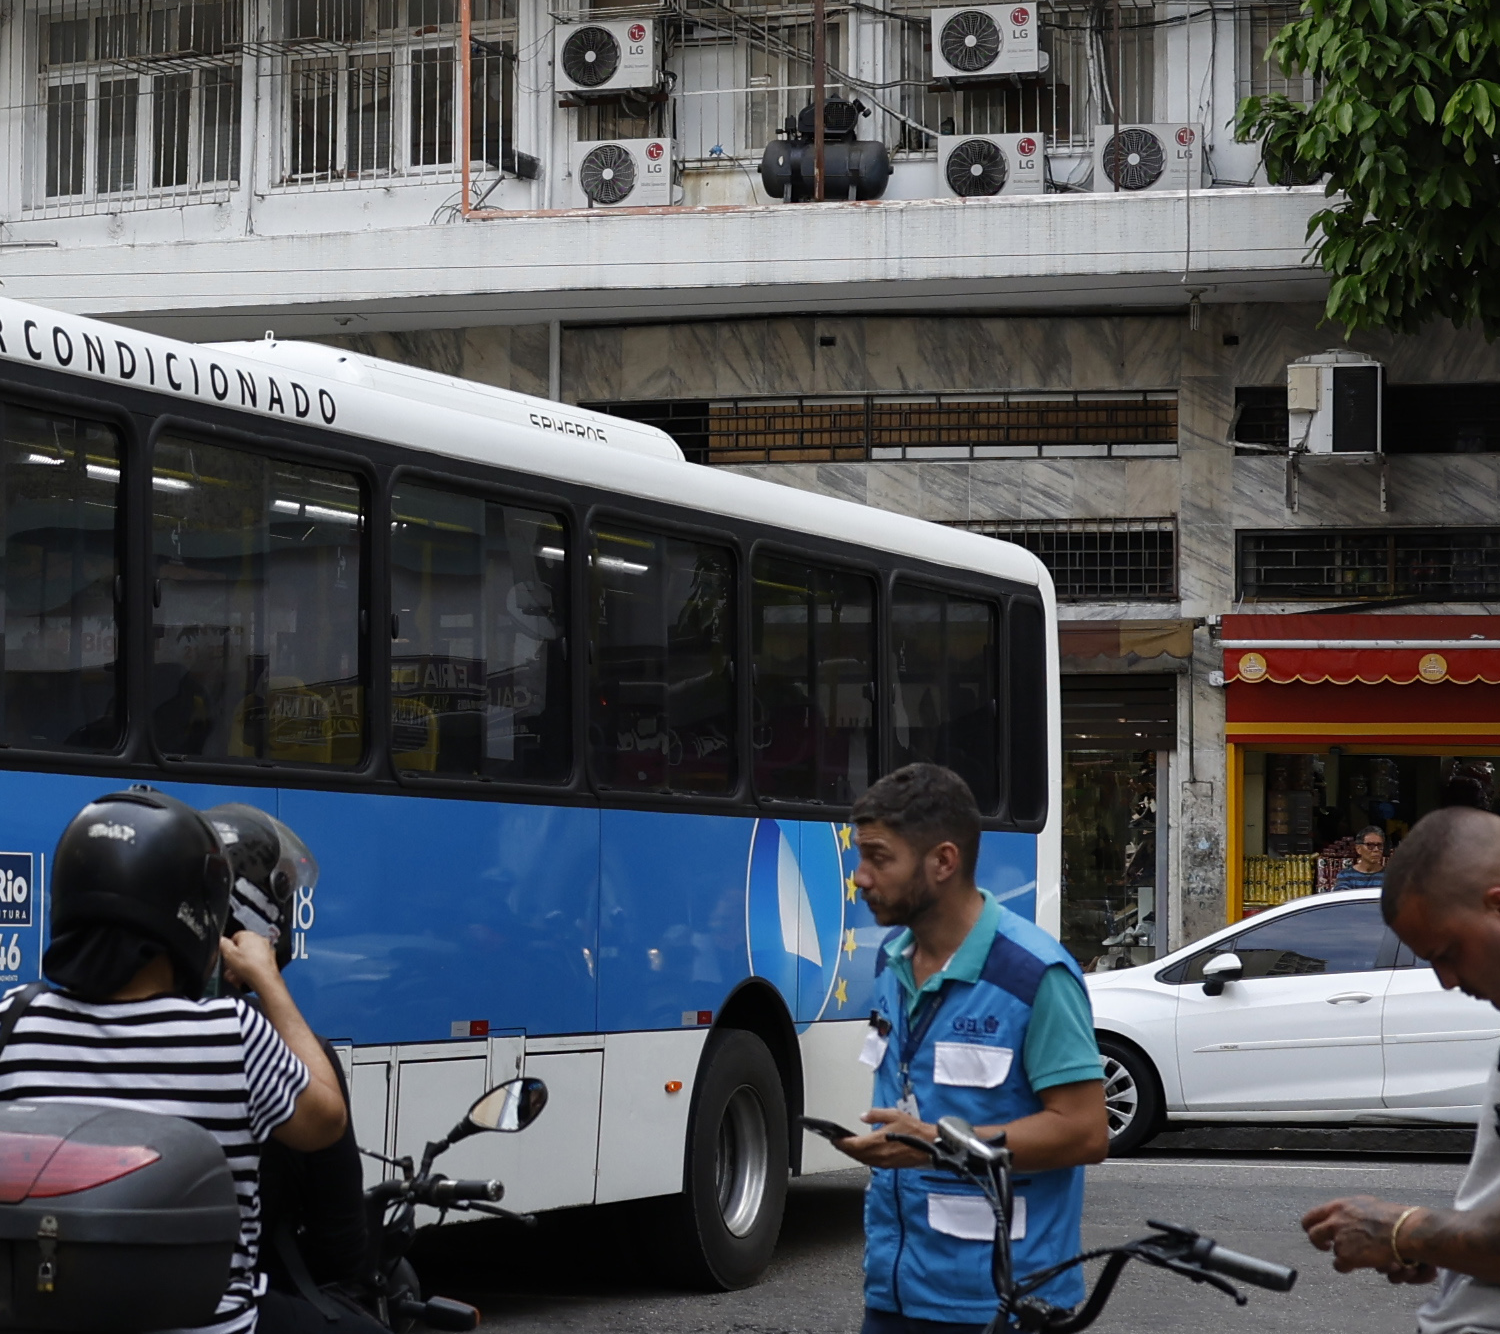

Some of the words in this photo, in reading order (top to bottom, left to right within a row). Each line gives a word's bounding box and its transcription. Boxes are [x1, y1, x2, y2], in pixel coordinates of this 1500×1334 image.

[1012, 29, 1028, 39] LG
[629, 44, 644, 55] LG
[1177, 150, 1193, 160] LG
[647, 163, 662, 174] LG
[1019, 159, 1035, 169] LG
[23, 319, 337, 424] CONDICIONADO
